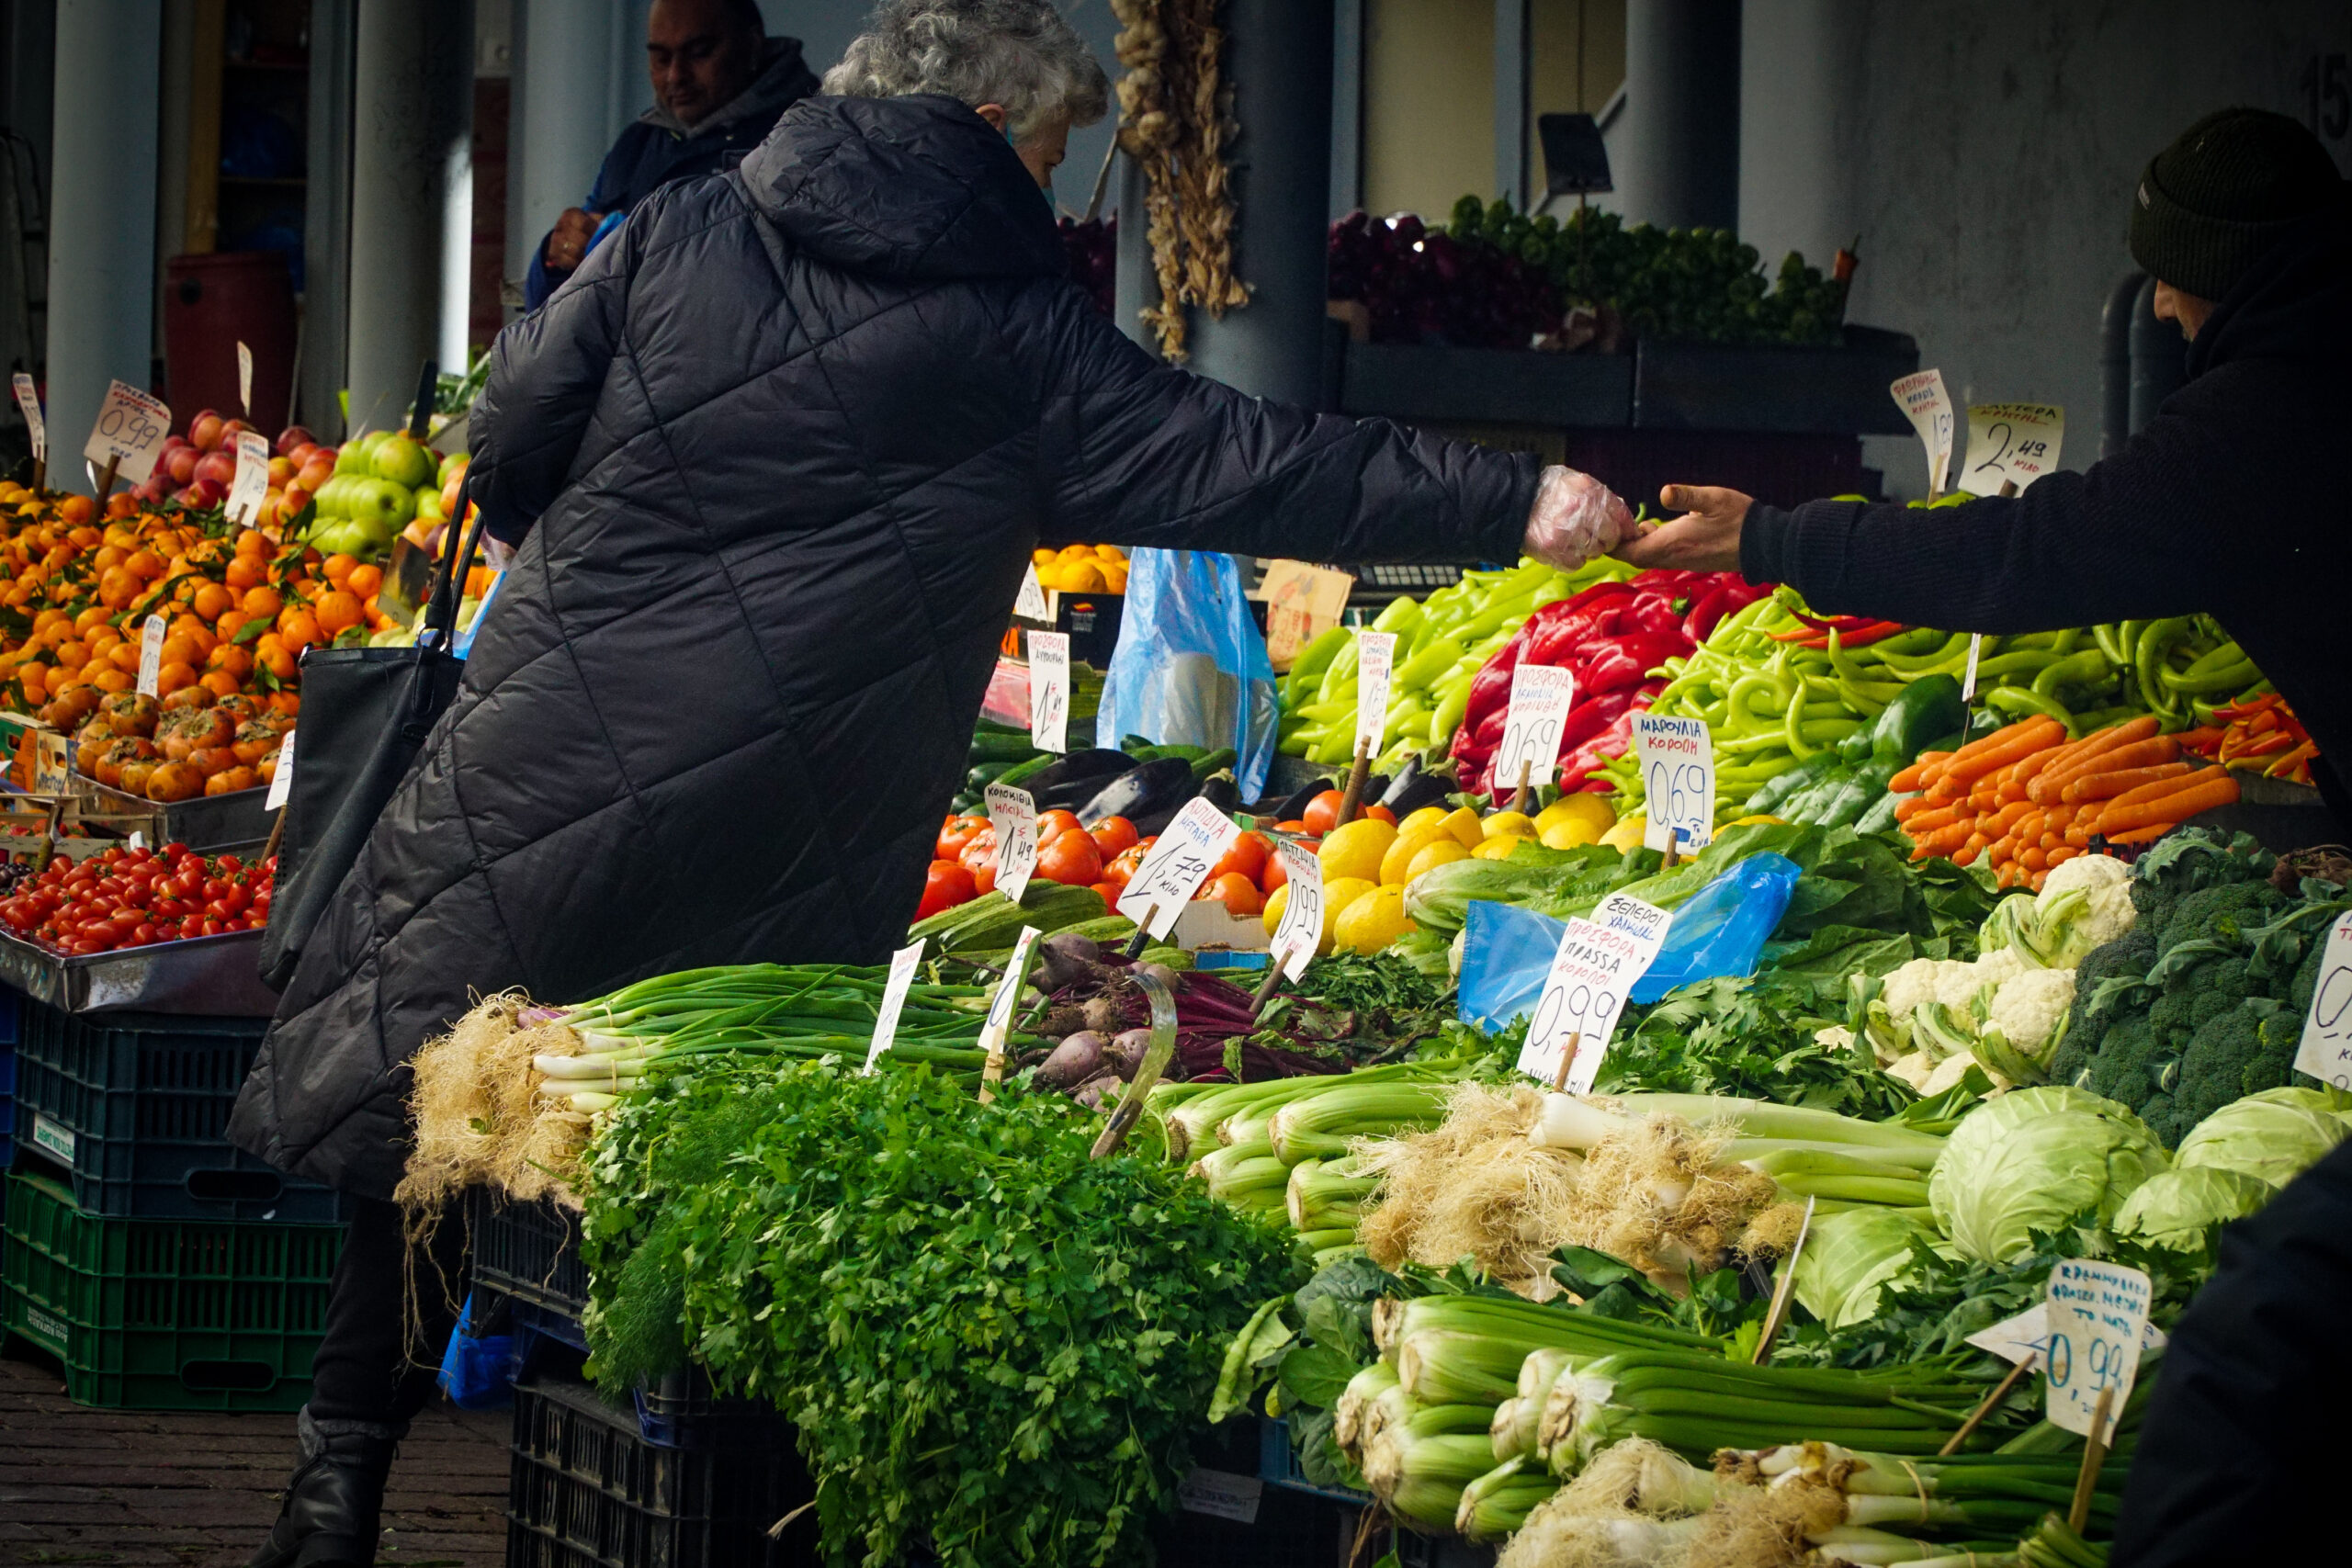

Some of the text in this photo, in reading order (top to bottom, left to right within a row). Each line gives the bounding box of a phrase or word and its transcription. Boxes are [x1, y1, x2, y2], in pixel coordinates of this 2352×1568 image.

[2300, 52, 2349, 140] 15
[1975, 423, 2047, 473] 2,49
[1514, 668, 1569, 689] ΠΡΟΣΦΟΡΑ
[1640, 718, 1702, 738] ΜΑΡΟΥΛΙΑ
[1650, 761, 1705, 830] 0,69
[1279, 878, 1317, 948] 0,99
[1565, 921, 1635, 961] ΠΡΟΣΦΟΡΑ
[1532, 985, 1617, 1055] 0,99
